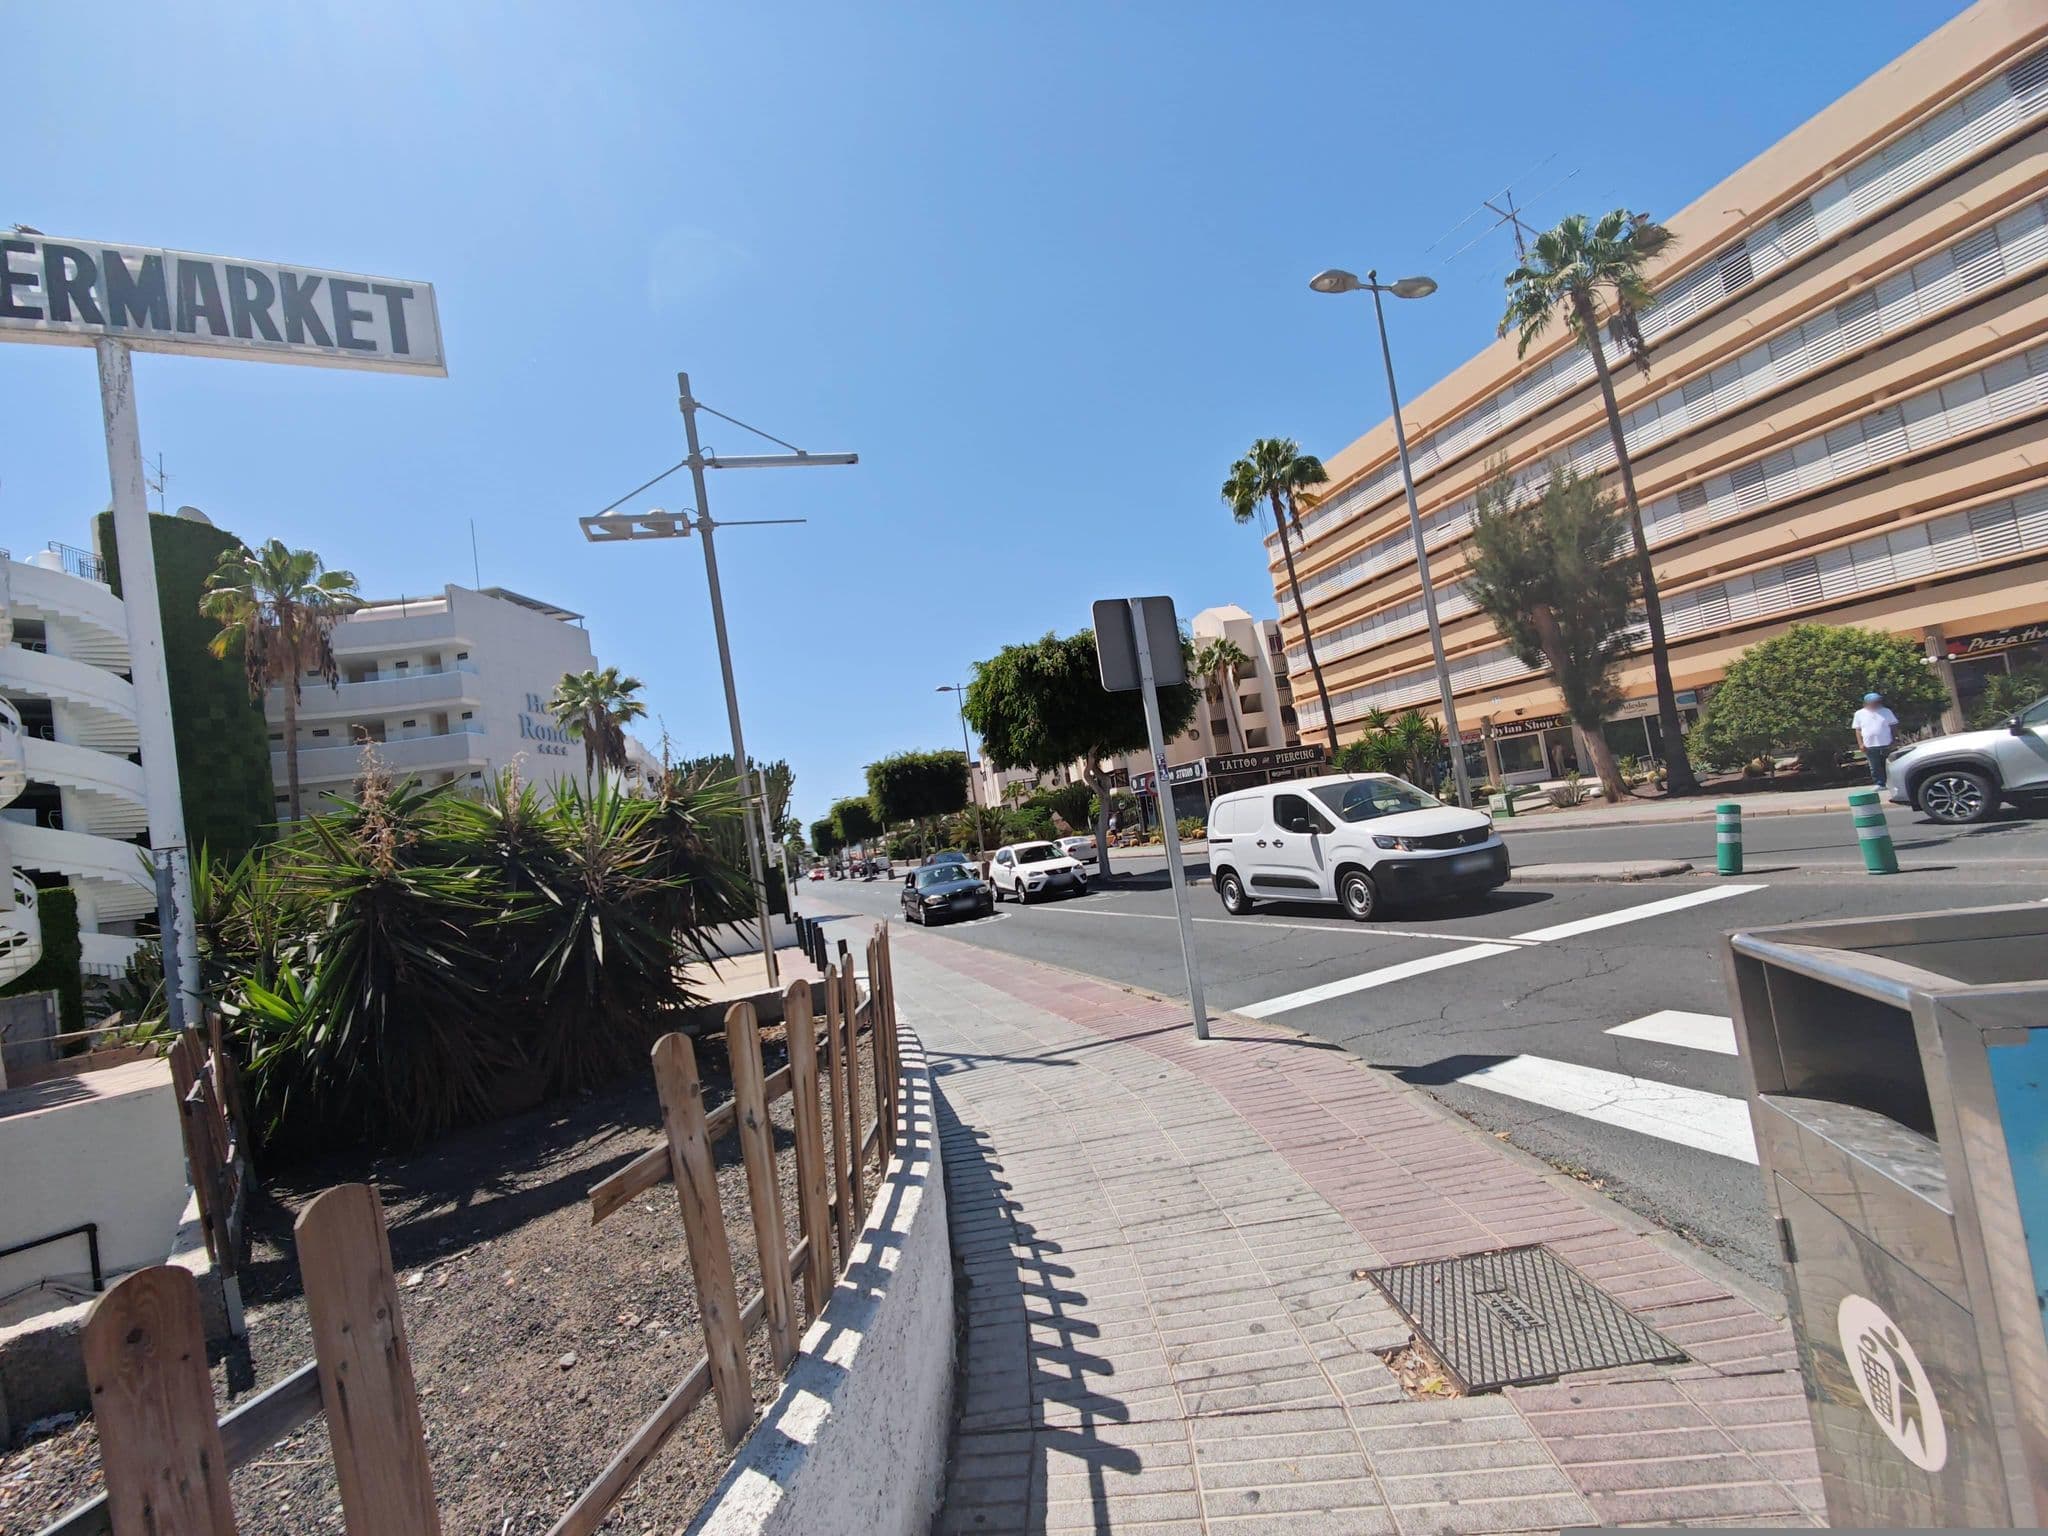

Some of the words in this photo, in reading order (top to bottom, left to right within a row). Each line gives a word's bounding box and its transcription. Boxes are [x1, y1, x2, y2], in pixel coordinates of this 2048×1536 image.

[0, 240, 414, 355] ERMARKET
[1967, 636, 2018, 652] Pizza
[1525, 719, 1553, 731] Shop
[1220, 757, 1257, 770] TATTOO
[1275, 749, 1314, 764] PIERCING
